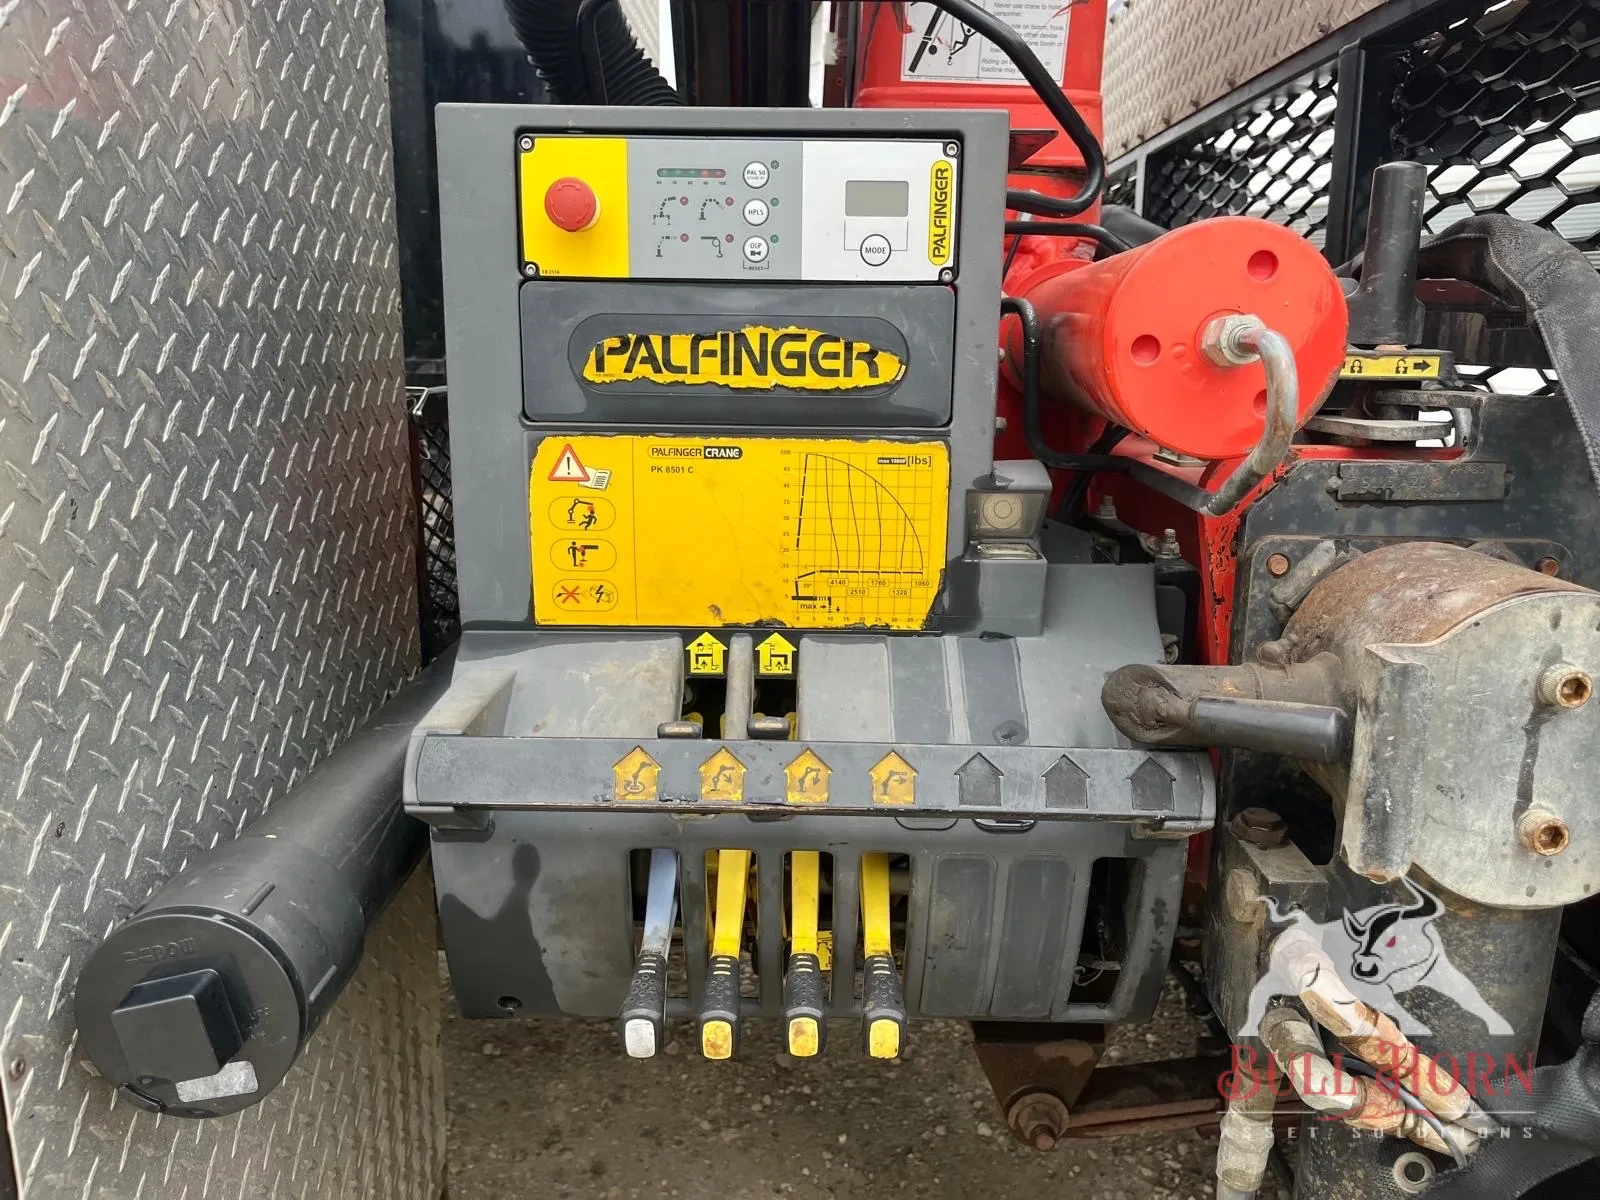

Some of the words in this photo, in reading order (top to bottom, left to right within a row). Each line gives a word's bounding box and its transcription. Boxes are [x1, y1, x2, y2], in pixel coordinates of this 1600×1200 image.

[748, 208, 764, 216] HPLS
[932, 167, 949, 258] PALFINGER
[595, 332, 880, 379] PALFINGER
[651, 447, 702, 457] PALFINGER
[705, 448, 740, 458] CRANE
[907, 455, 932, 467] [lbs]
